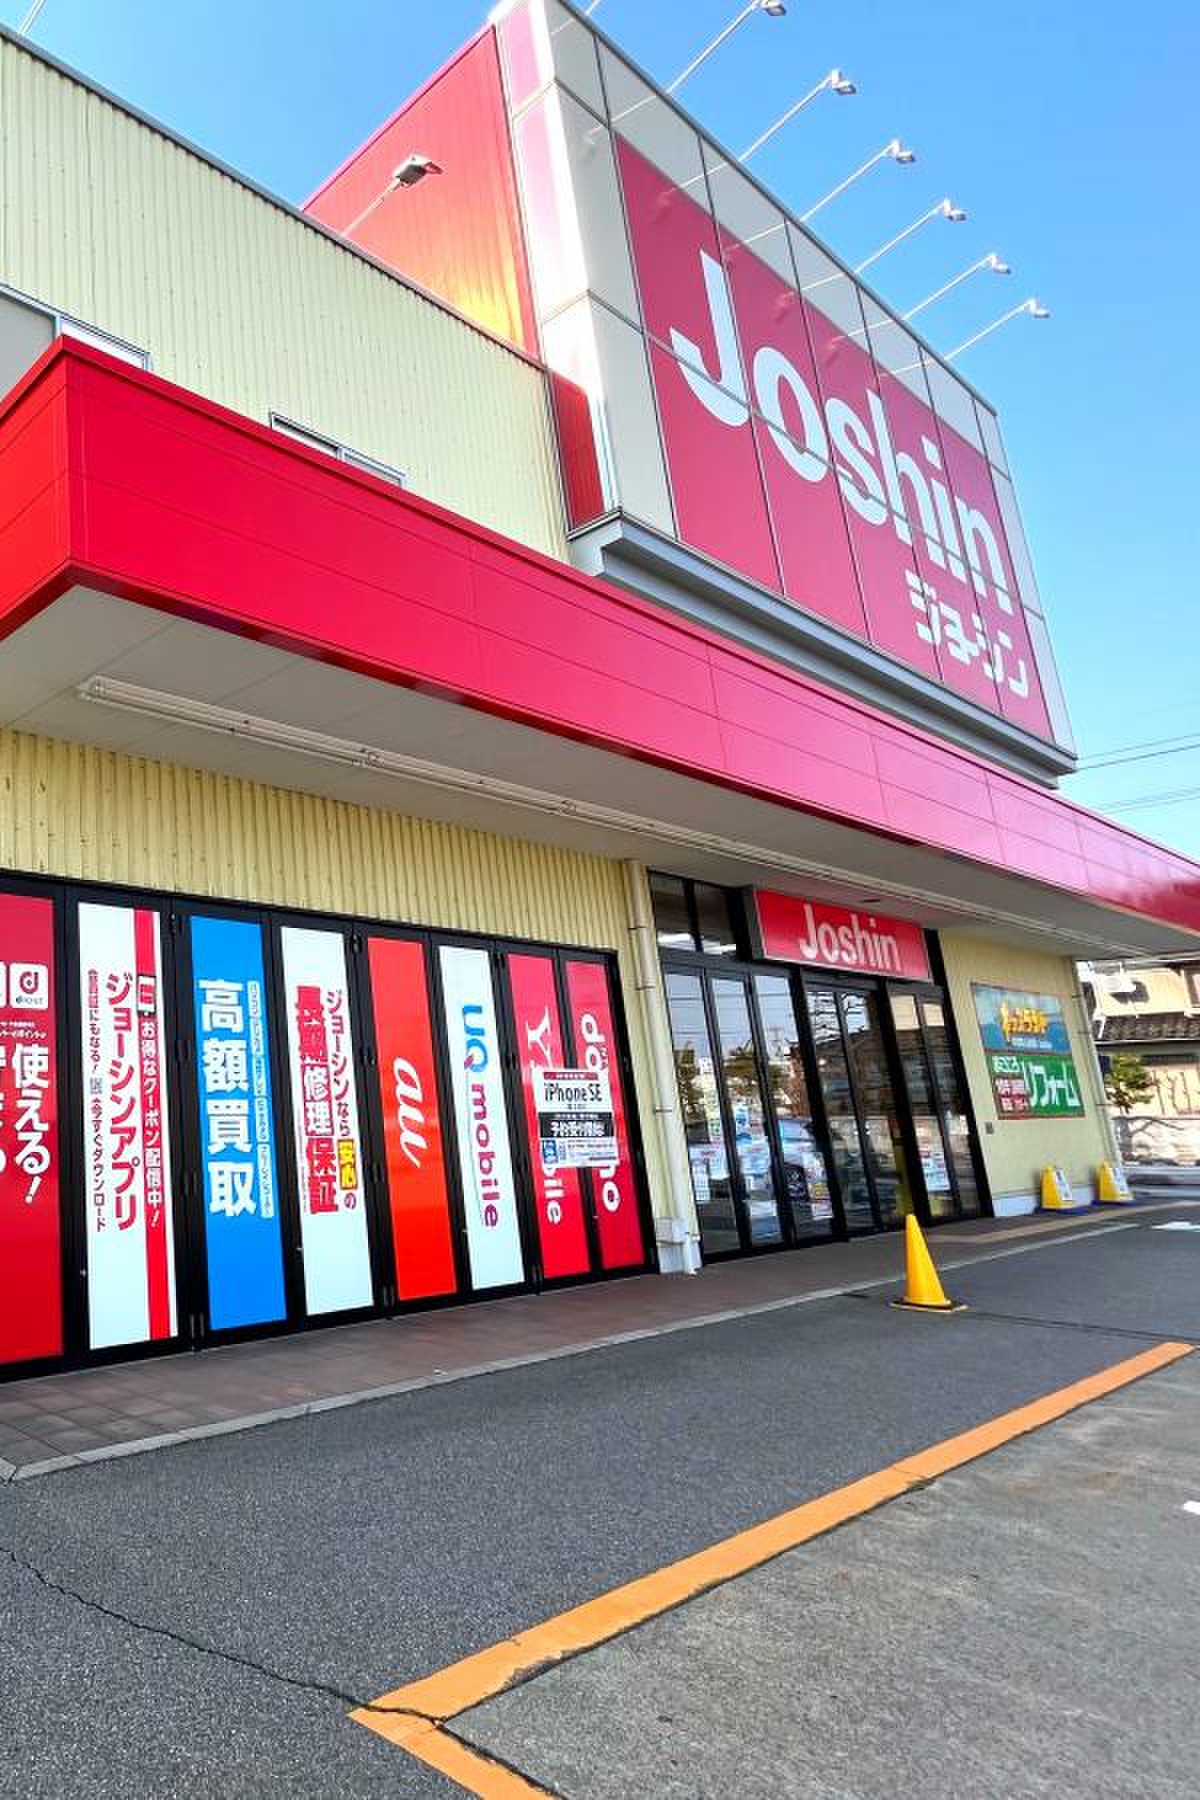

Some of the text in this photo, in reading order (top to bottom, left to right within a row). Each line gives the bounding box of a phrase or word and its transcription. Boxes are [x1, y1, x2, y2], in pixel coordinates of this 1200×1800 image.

[669, 248, 1013, 616] Joshin
[905, 568, 1029, 699] ジョーシン
[798, 902, 902, 972] Joshin
[106, 971, 140, 1231] ジョーシンアプリ
[199, 979, 257, 1218] 高額買取
[393, 1056, 430, 1168] au
[462, 1004, 500, 1228] UQ mobile
[544, 1082, 588, 1102] iPhone
[581, 1013, 620, 1213] doo
[1020, 1060, 1081, 1107] リフォーム
